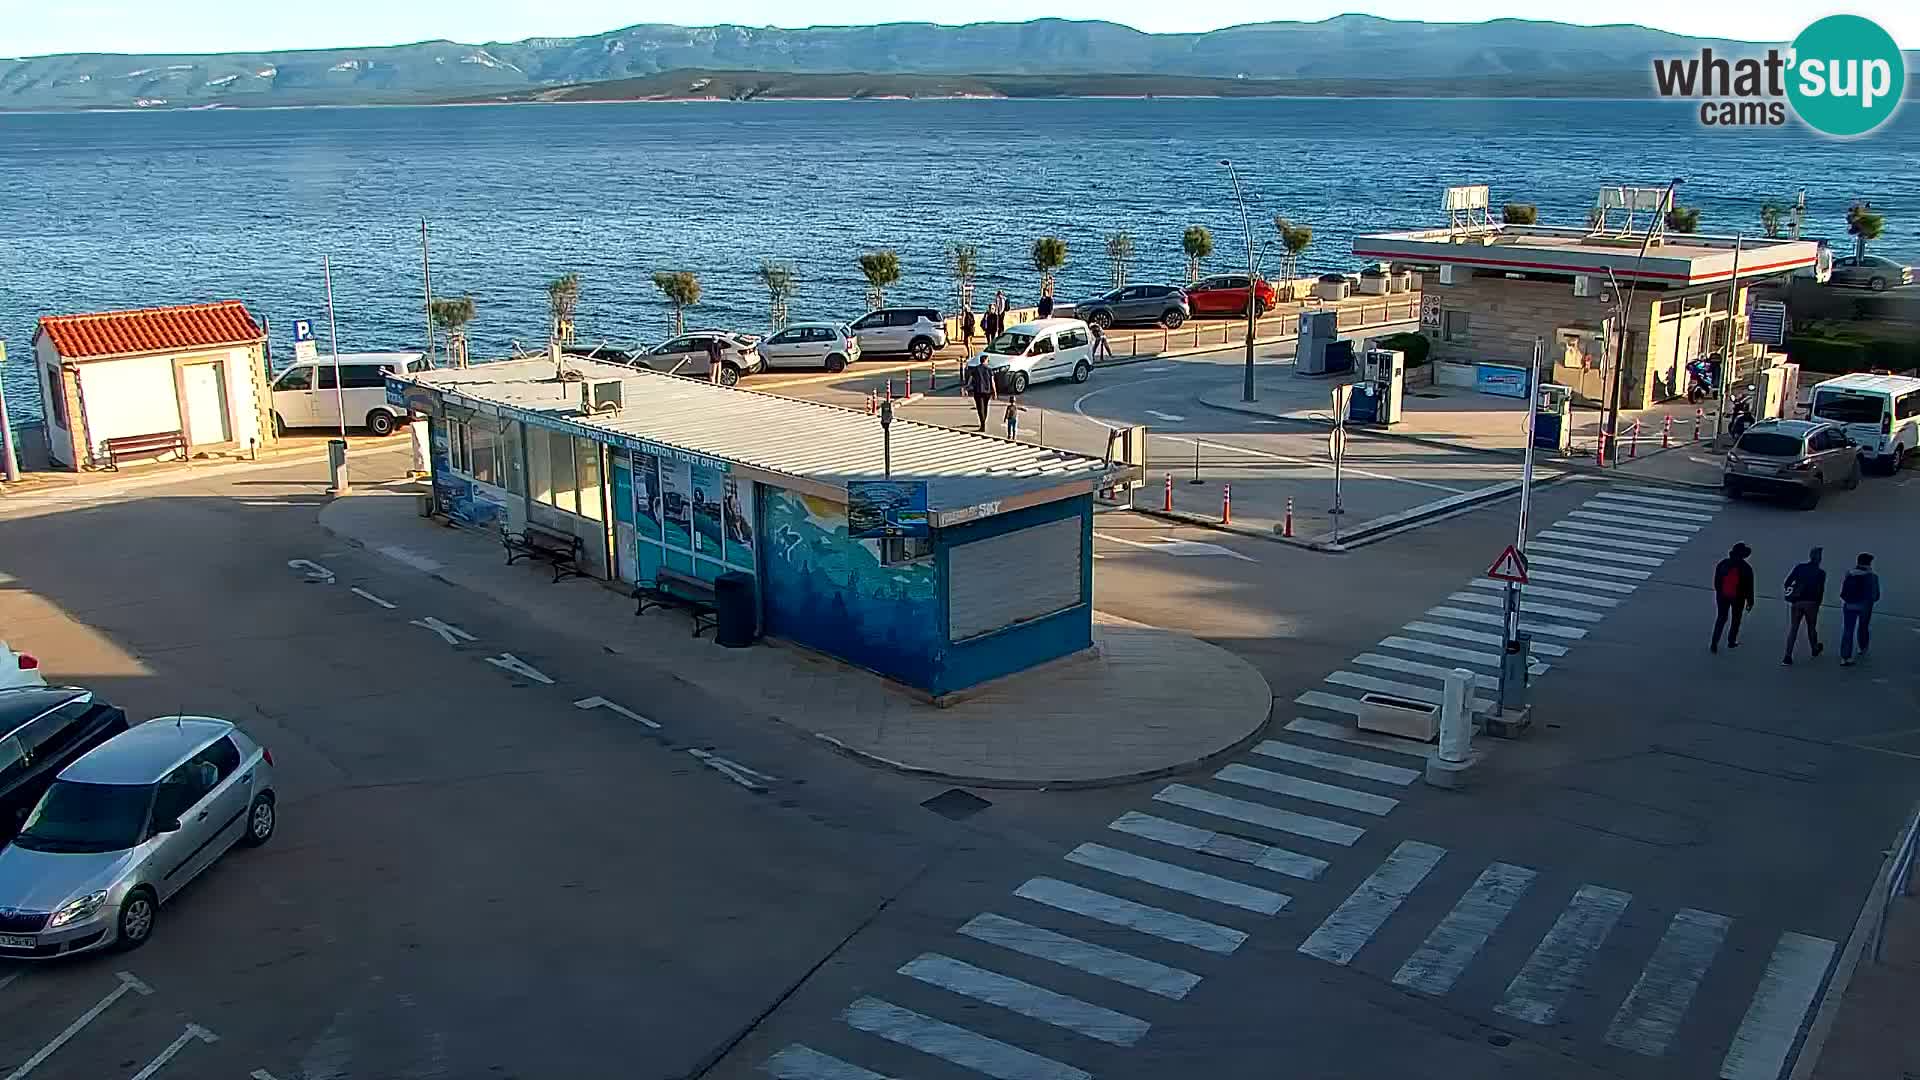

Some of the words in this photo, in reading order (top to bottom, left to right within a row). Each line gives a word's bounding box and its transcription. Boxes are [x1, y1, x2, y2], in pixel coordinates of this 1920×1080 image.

[297, 321, 310, 340] P
[625, 438, 641, 451] BUS
[641, 442, 673, 458] STATION
[676, 450, 700, 465] TICKET
[700, 456, 727, 472] OFFICE
